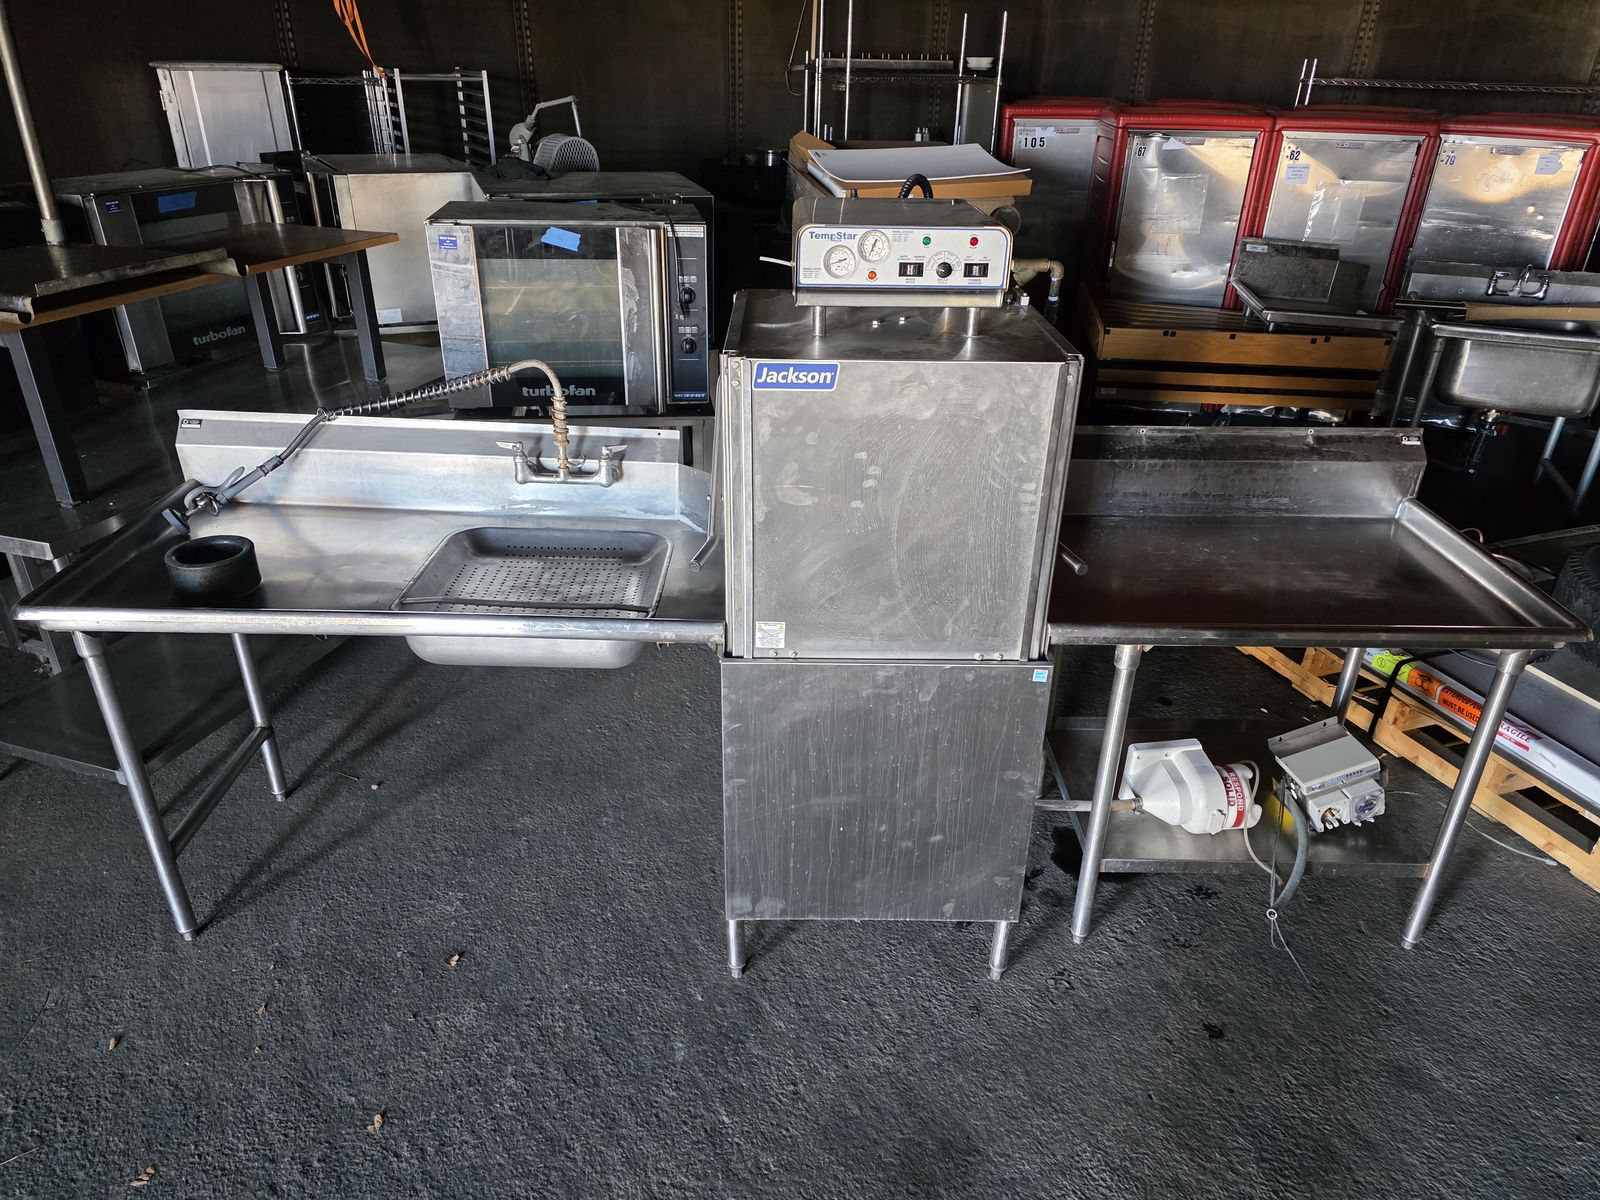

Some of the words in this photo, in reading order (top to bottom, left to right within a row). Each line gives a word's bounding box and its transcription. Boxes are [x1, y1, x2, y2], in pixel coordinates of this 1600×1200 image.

[1024, 136, 1046, 148] 105
[1137, 146, 1147, 157] 67
[1289, 150, 1301, 161] 62
[1444, 154, 1456, 166] 79
[808, 231, 857, 241] TempStar
[192, 325, 246, 346] turbofan
[757, 366, 832, 384] Jackson
[1441, 685, 1472, 705] EXTENDED
[1442, 697, 1457, 710] MUST
[1457, 705, 1465, 714] BE
[1223, 776, 1236, 807] SOLID
[1229, 772, 1244, 812] RESPOND
